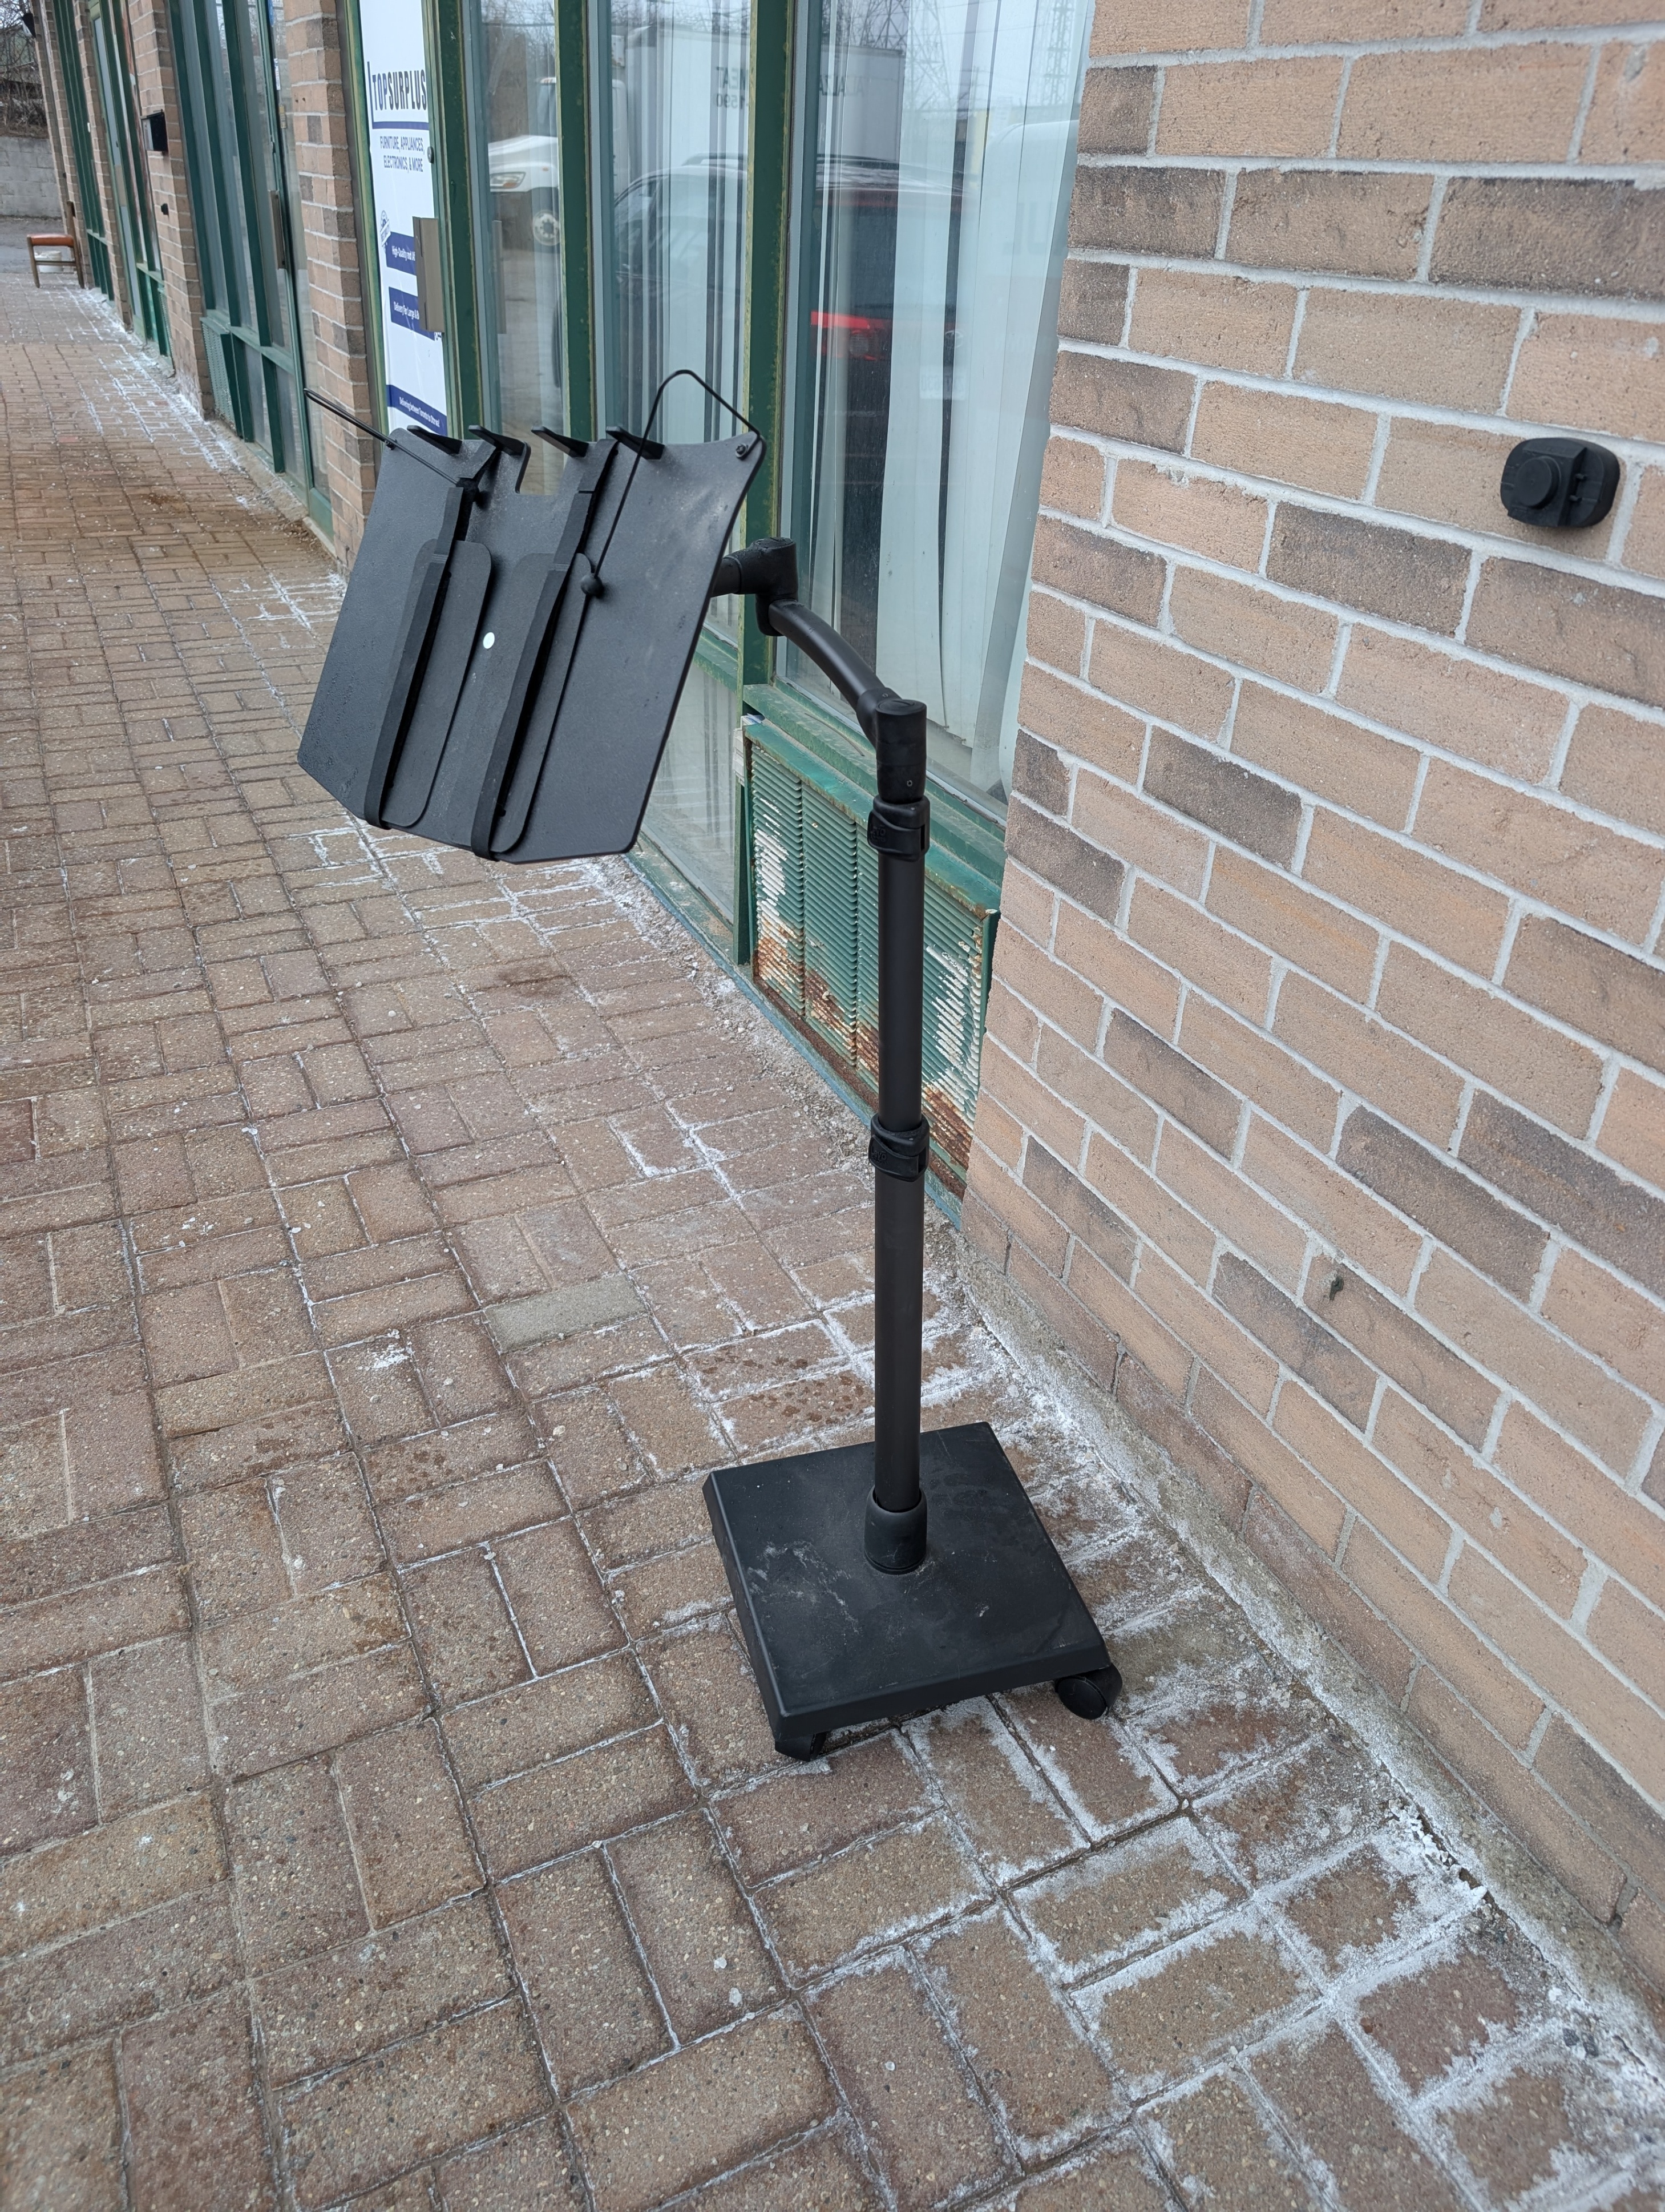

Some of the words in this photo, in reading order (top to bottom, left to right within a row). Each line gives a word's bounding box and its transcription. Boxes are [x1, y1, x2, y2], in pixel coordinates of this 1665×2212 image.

[372, 69, 427, 111] TOPSURPLUS
[379, 136, 401, 152] FURNITURE,
[401, 136, 425, 155] APPLIANCES,
[383, 155, 409, 173] ELECTRONICS,
[409, 157, 412, 171] &
[412, 157, 423, 172] MORE
